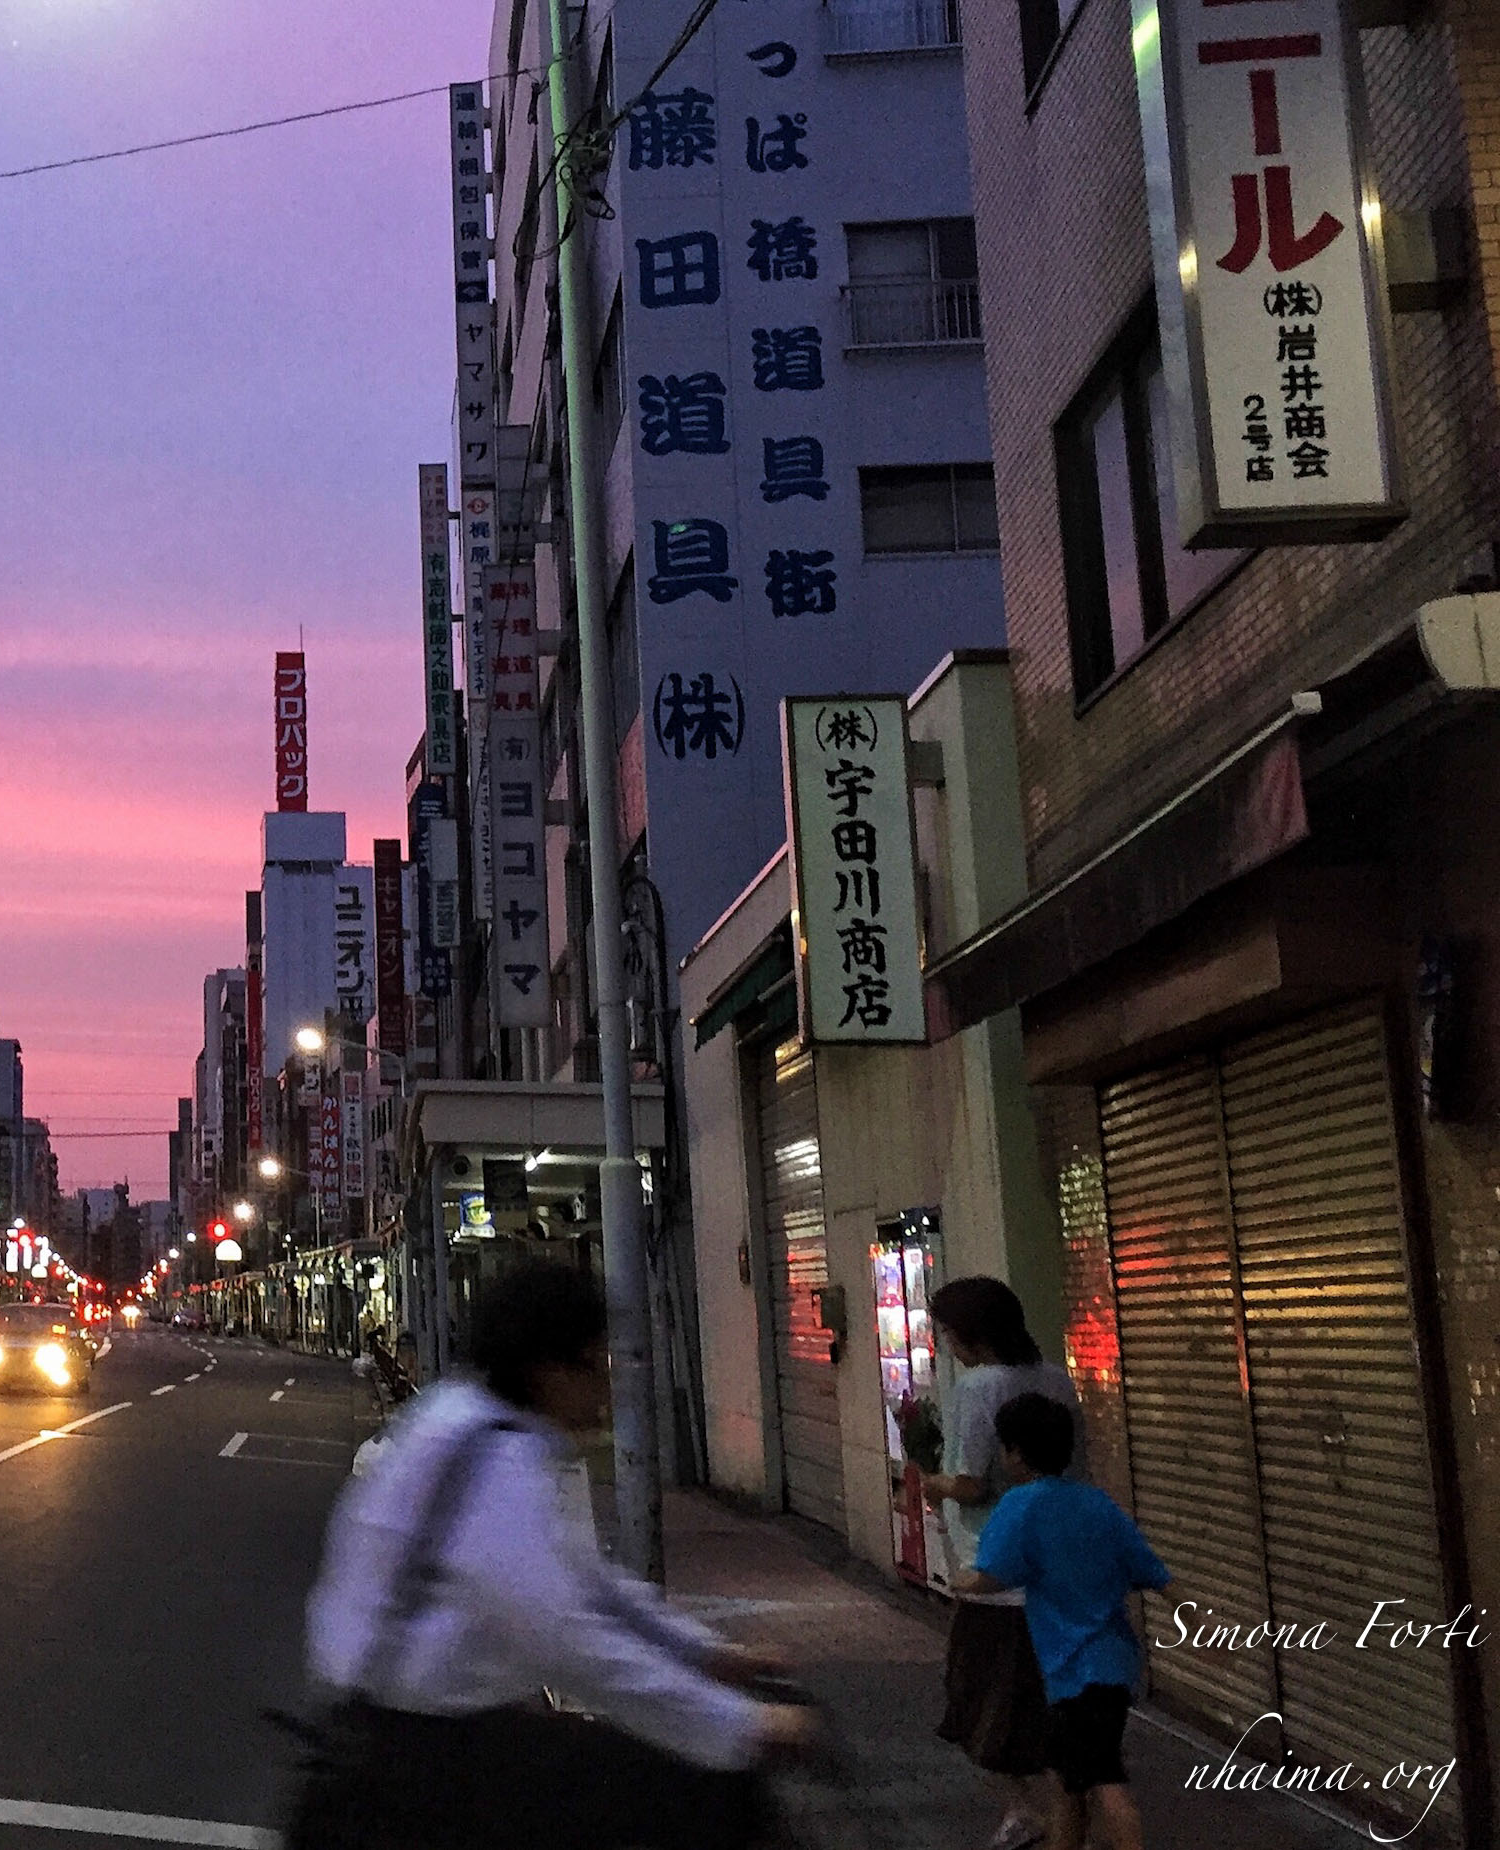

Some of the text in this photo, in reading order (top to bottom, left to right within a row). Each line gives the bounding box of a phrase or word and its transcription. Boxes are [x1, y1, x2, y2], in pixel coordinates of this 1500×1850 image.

[1242, 395, 1275, 482] 2号店
[278, 668, 305, 799] プロパック
